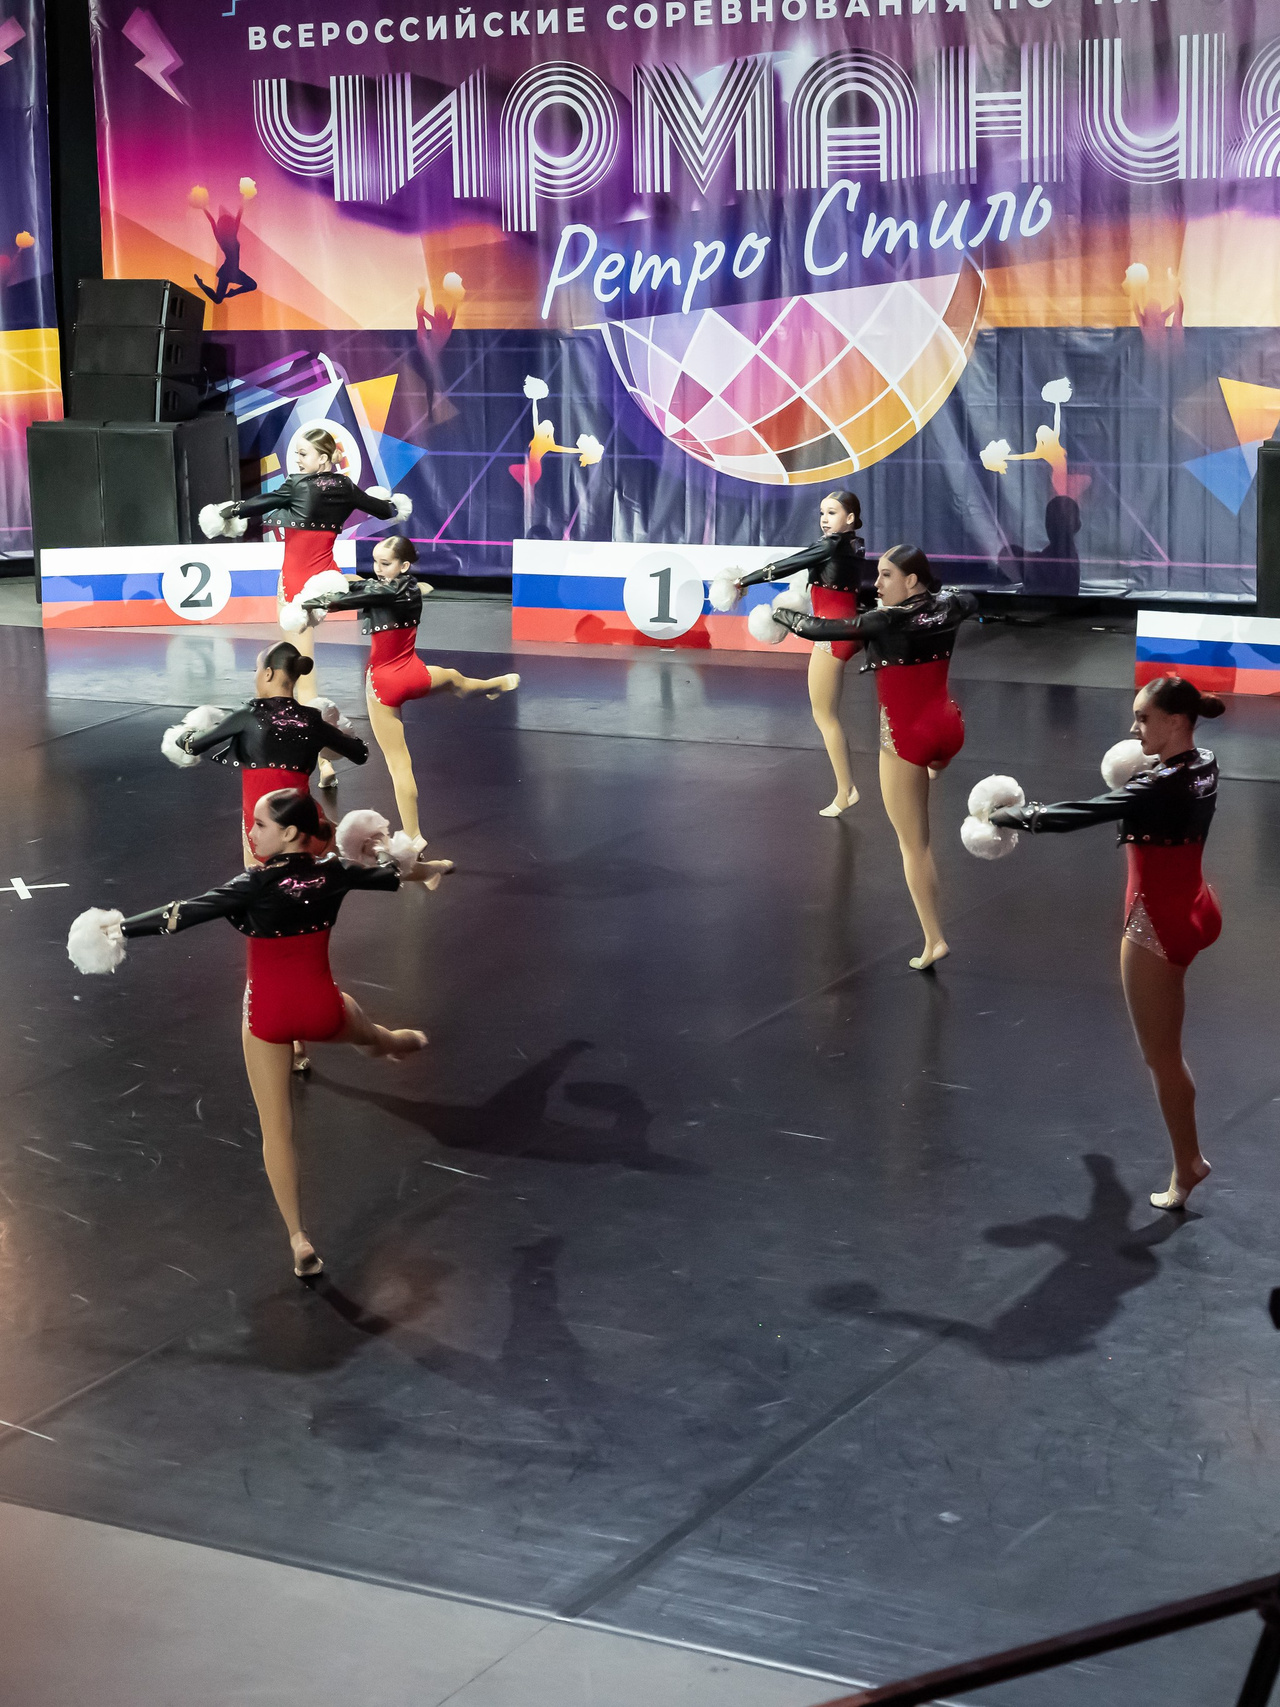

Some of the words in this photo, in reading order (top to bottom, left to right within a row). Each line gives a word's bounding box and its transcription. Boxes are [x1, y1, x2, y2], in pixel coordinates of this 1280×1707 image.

[248, 7, 586, 50] ВСЕРОССИЙСКИЕ
[253, 32, 1280, 232] ЧИРМАНИ
[541, 223, 771, 319] Ретро
[804, 178, 1053, 276] Стиль
[180, 561, 213, 608] 2
[649, 567, 677, 623] 1
